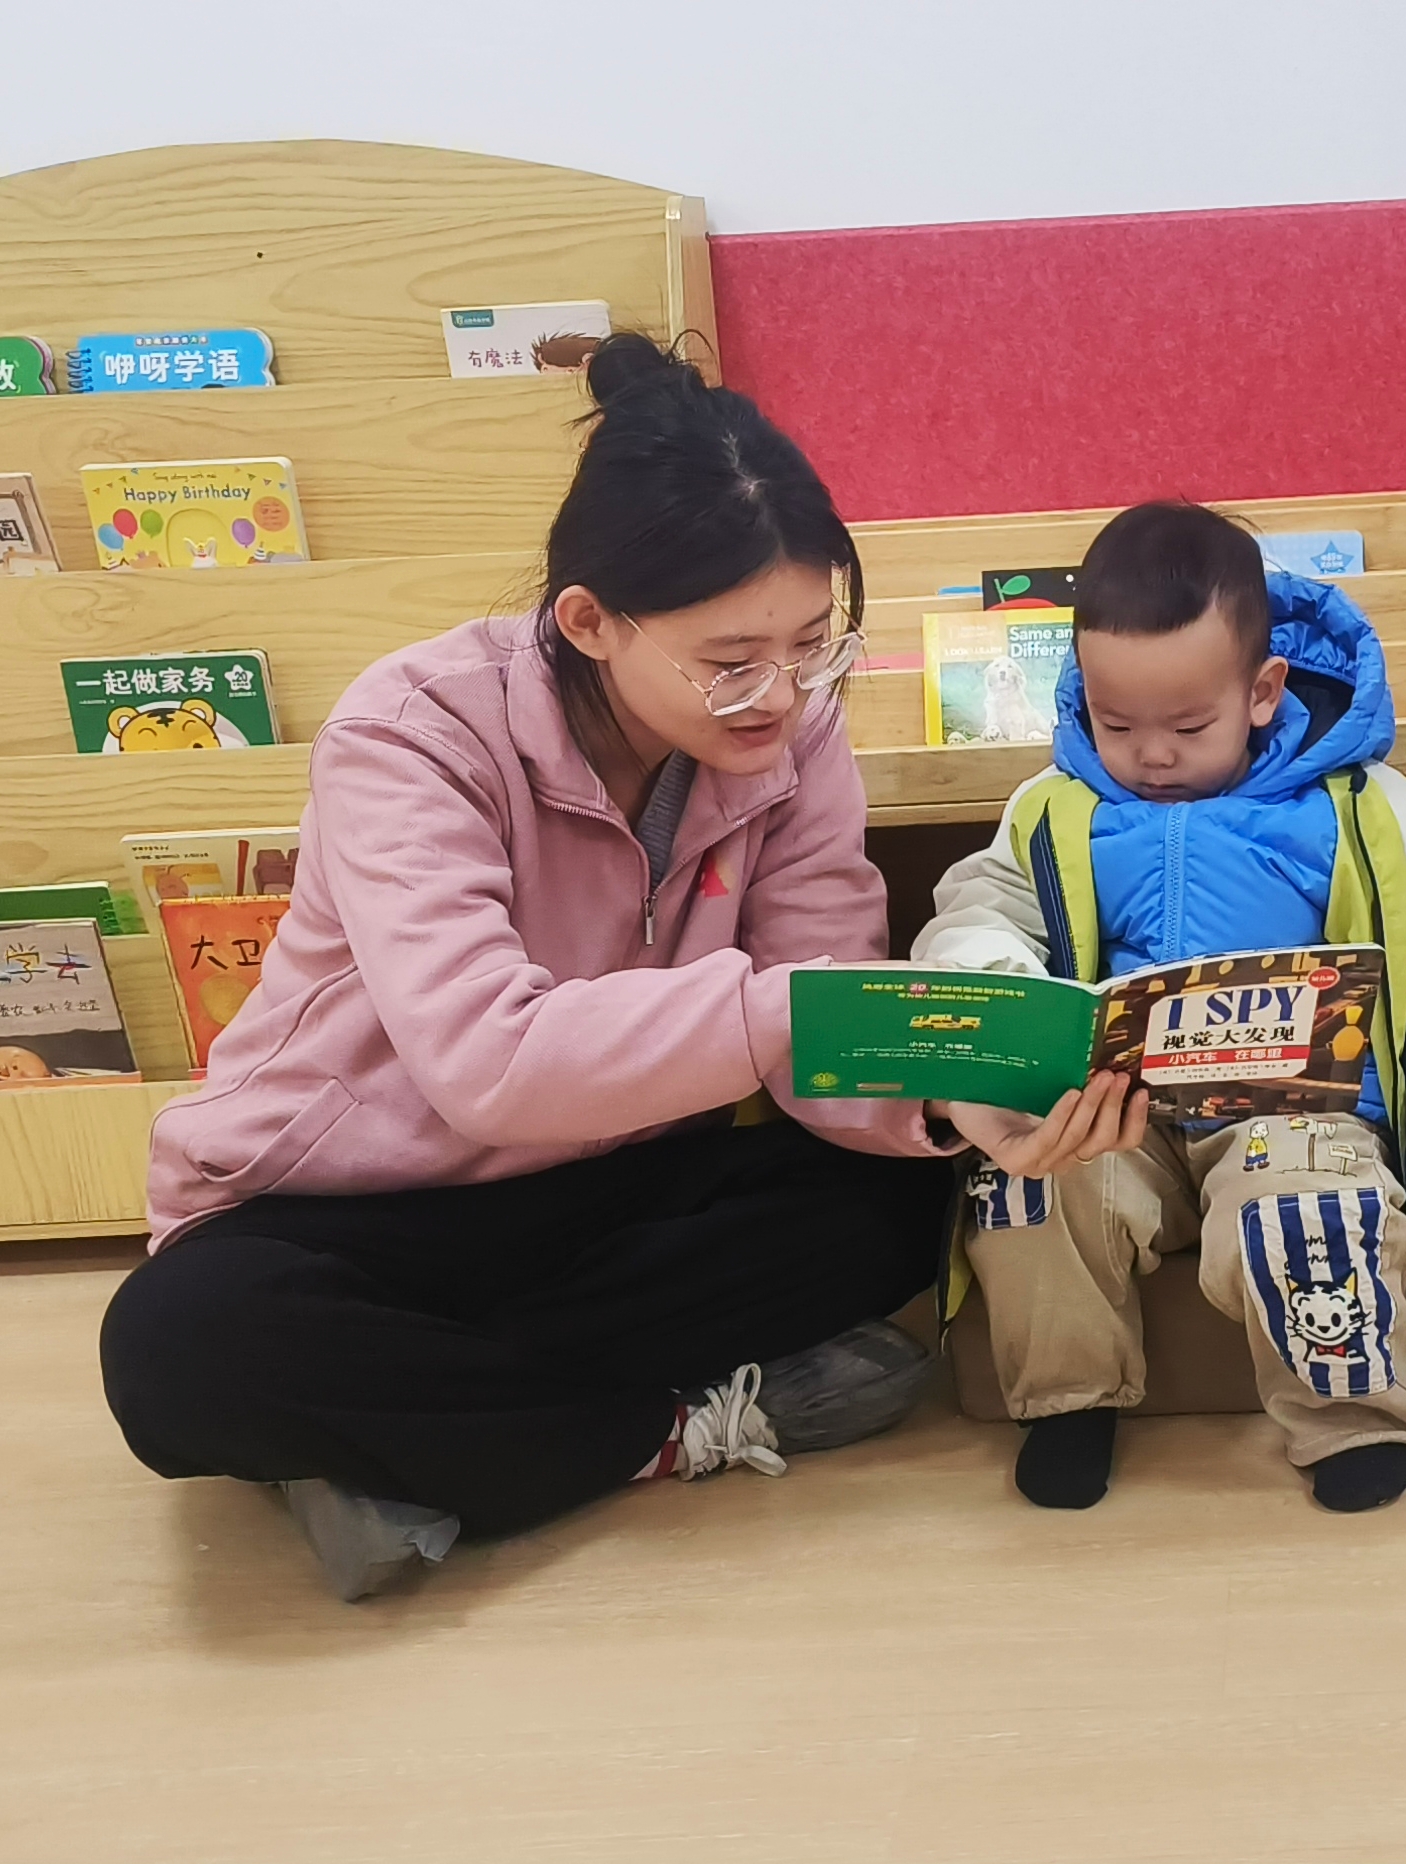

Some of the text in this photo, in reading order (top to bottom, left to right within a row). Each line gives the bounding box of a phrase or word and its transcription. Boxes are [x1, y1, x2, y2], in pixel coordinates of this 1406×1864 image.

[105, 349, 241, 384] 咿呀学语
[468, 348, 523, 368] 有魔法
[124, 484, 251, 504] Happy Birthday
[1009, 626, 1052, 641] Same
[1055, 628, 1073, 640] an
[1011, 642, 1070, 658] Differe
[75, 666, 216, 695] 一起做家务
[0, 943, 93, 985] 学去
[190, 935, 262, 970] 大卫
[1163, 985, 1307, 1031] I SPY
[1163, 1025, 1295, 1050] 视觉大发现
[1168, 1047, 1283, 1065] 小汽车 在哪里
